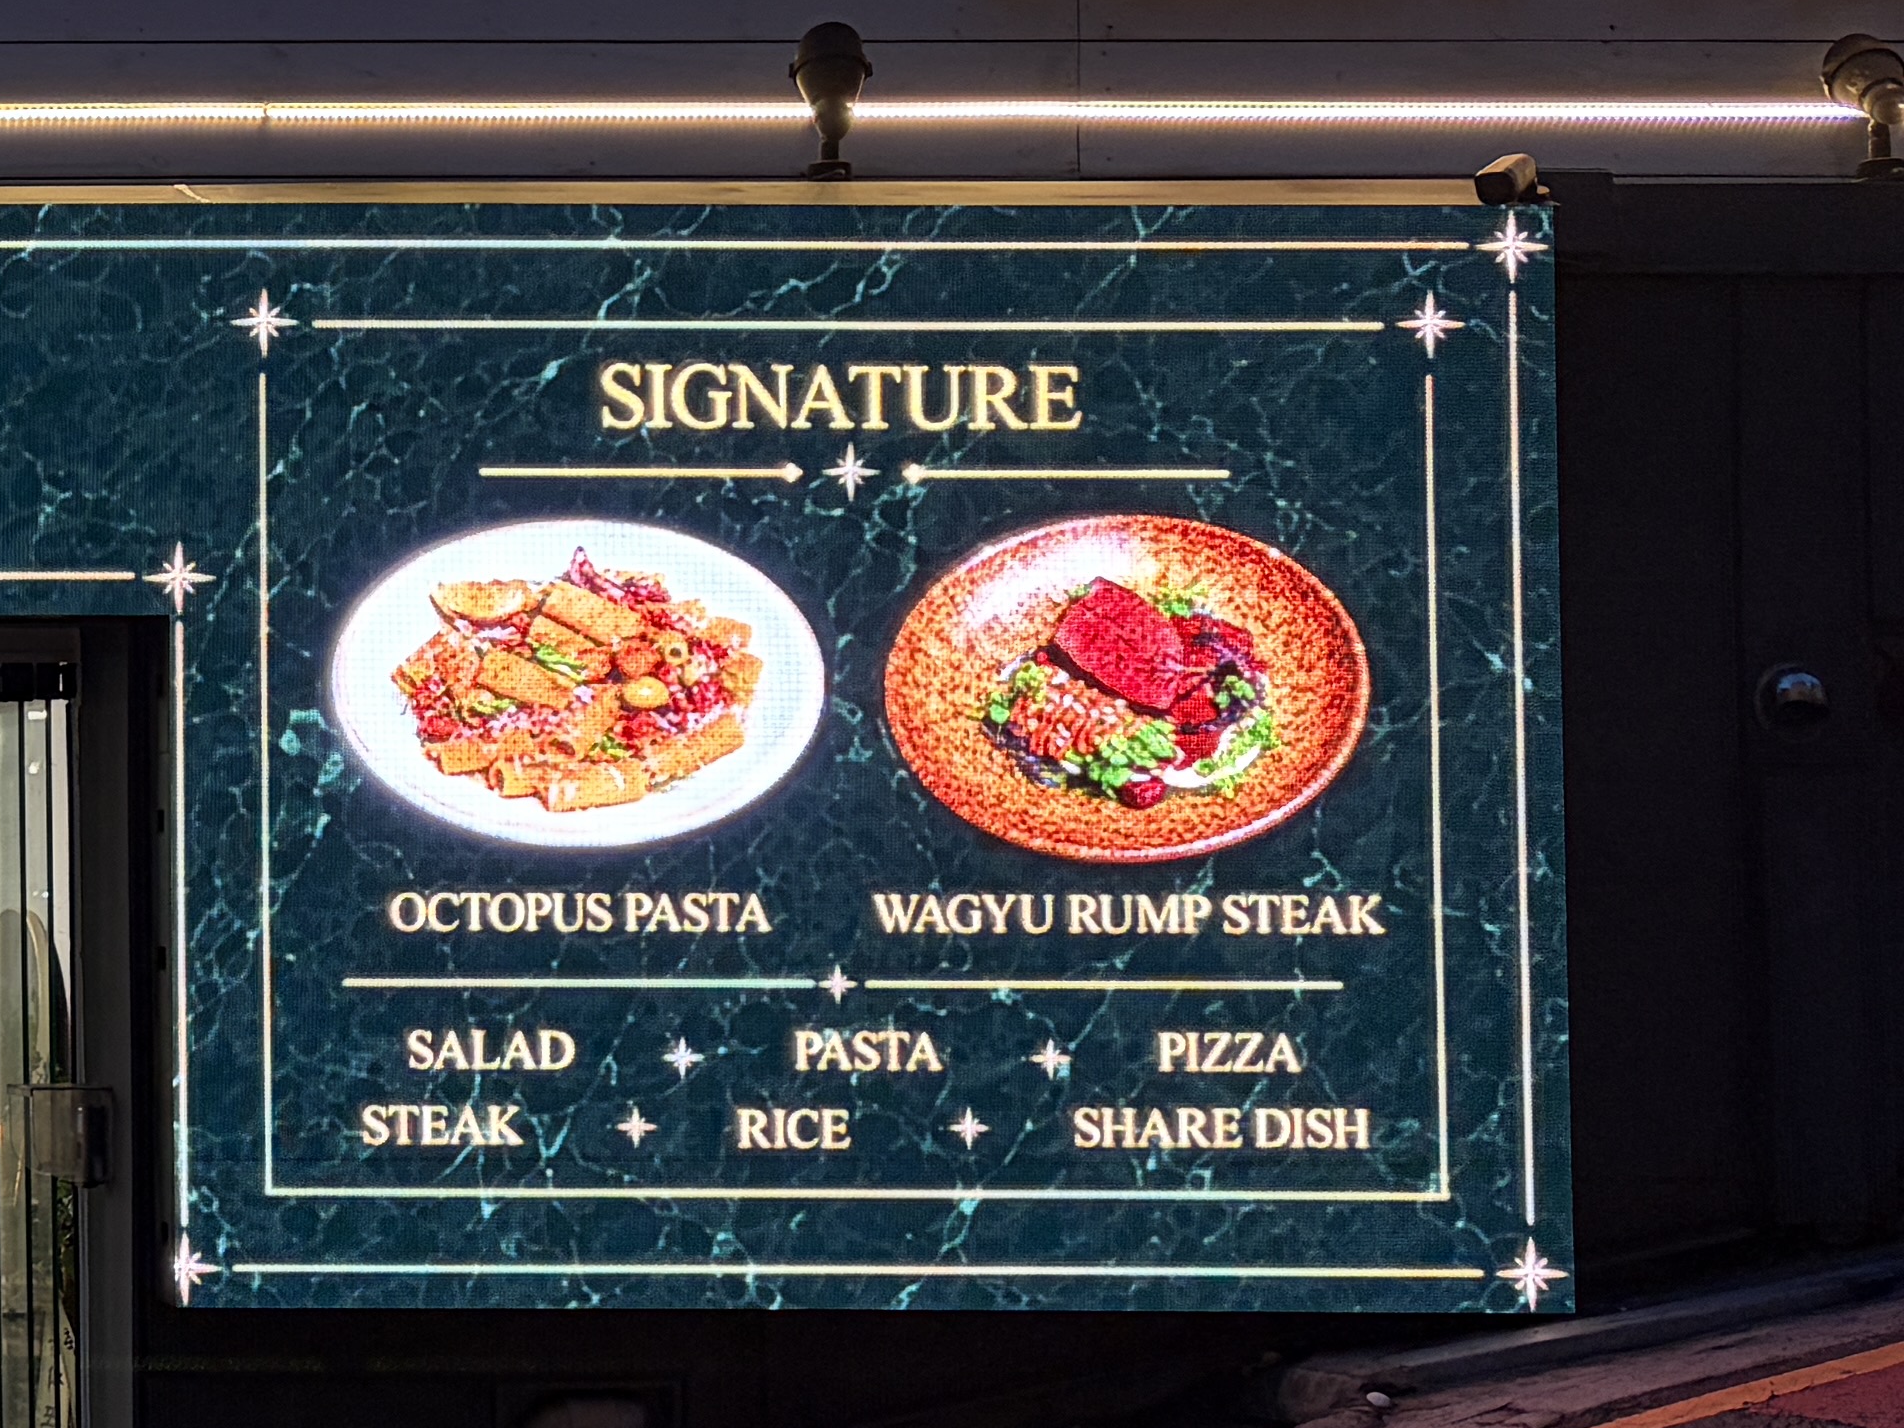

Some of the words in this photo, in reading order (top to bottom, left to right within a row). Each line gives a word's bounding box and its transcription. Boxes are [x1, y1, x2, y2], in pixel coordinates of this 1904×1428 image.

[600, 362, 1083, 432] SIGNATURE
[389, 891, 614, 935] OCTOPUS
[624, 891, 773, 935] PASTA
[872, 893, 1057, 936] WAGYU
[1066, 893, 1212, 936] RUMP
[1220, 892, 1387, 937] STEAK
[407, 1028, 577, 1073] SALAD
[793, 1028, 944, 1074] PASTA
[1157, 1031, 1304, 1075] PIZZA
[359, 1102, 525, 1149] STEAK
[736, 1107, 852, 1152] RICE
[1073, 1106, 1243, 1152] SHARE
[1253, 1107, 1371, 1152] DISH
